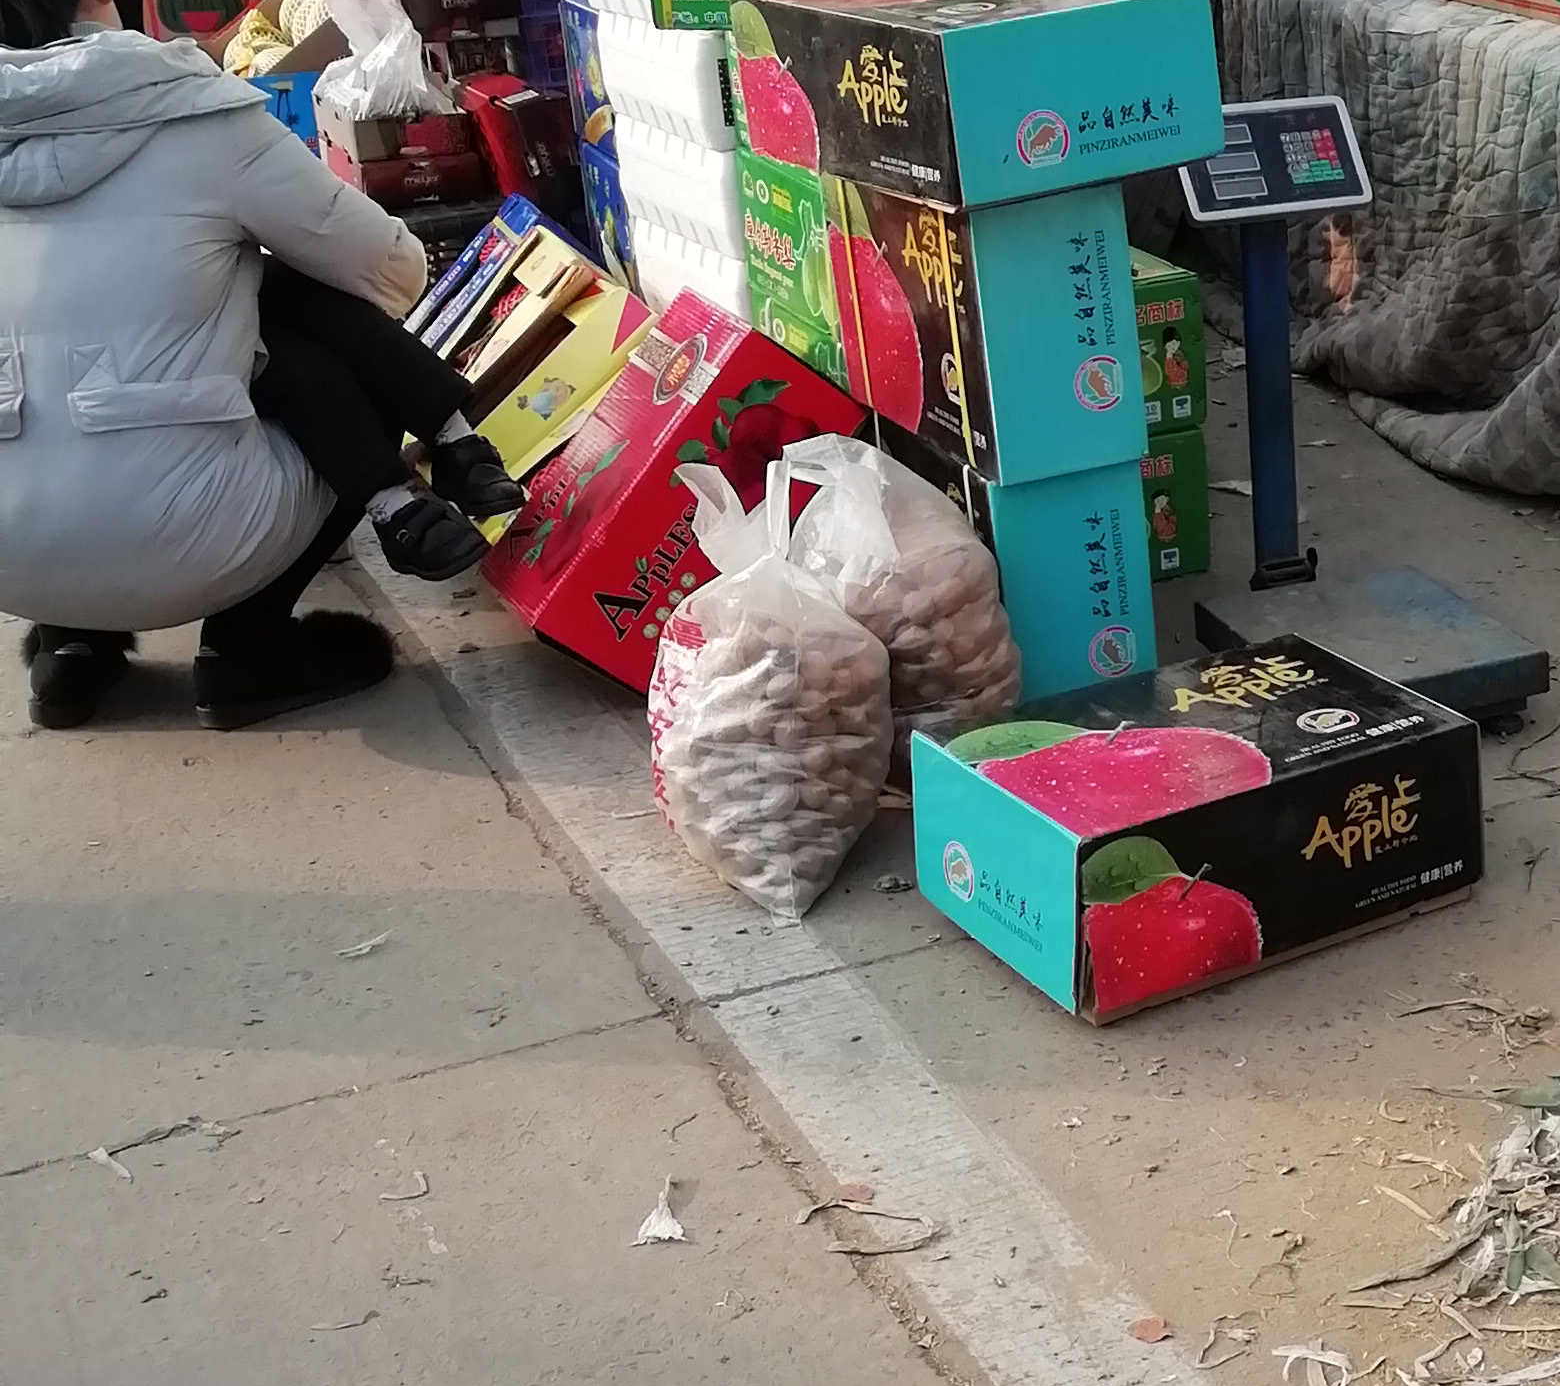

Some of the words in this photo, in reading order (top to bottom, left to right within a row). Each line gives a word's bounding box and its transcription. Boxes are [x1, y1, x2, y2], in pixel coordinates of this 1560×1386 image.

[838, 59, 909, 127] Apple
[1077, 93, 1182, 135] 品自然美味
[1079, 123, 1183, 156] PINZIRANMEIWEI
[1169, 667, 1314, 713] Apple
[1300, 795, 1419, 869] Apple
